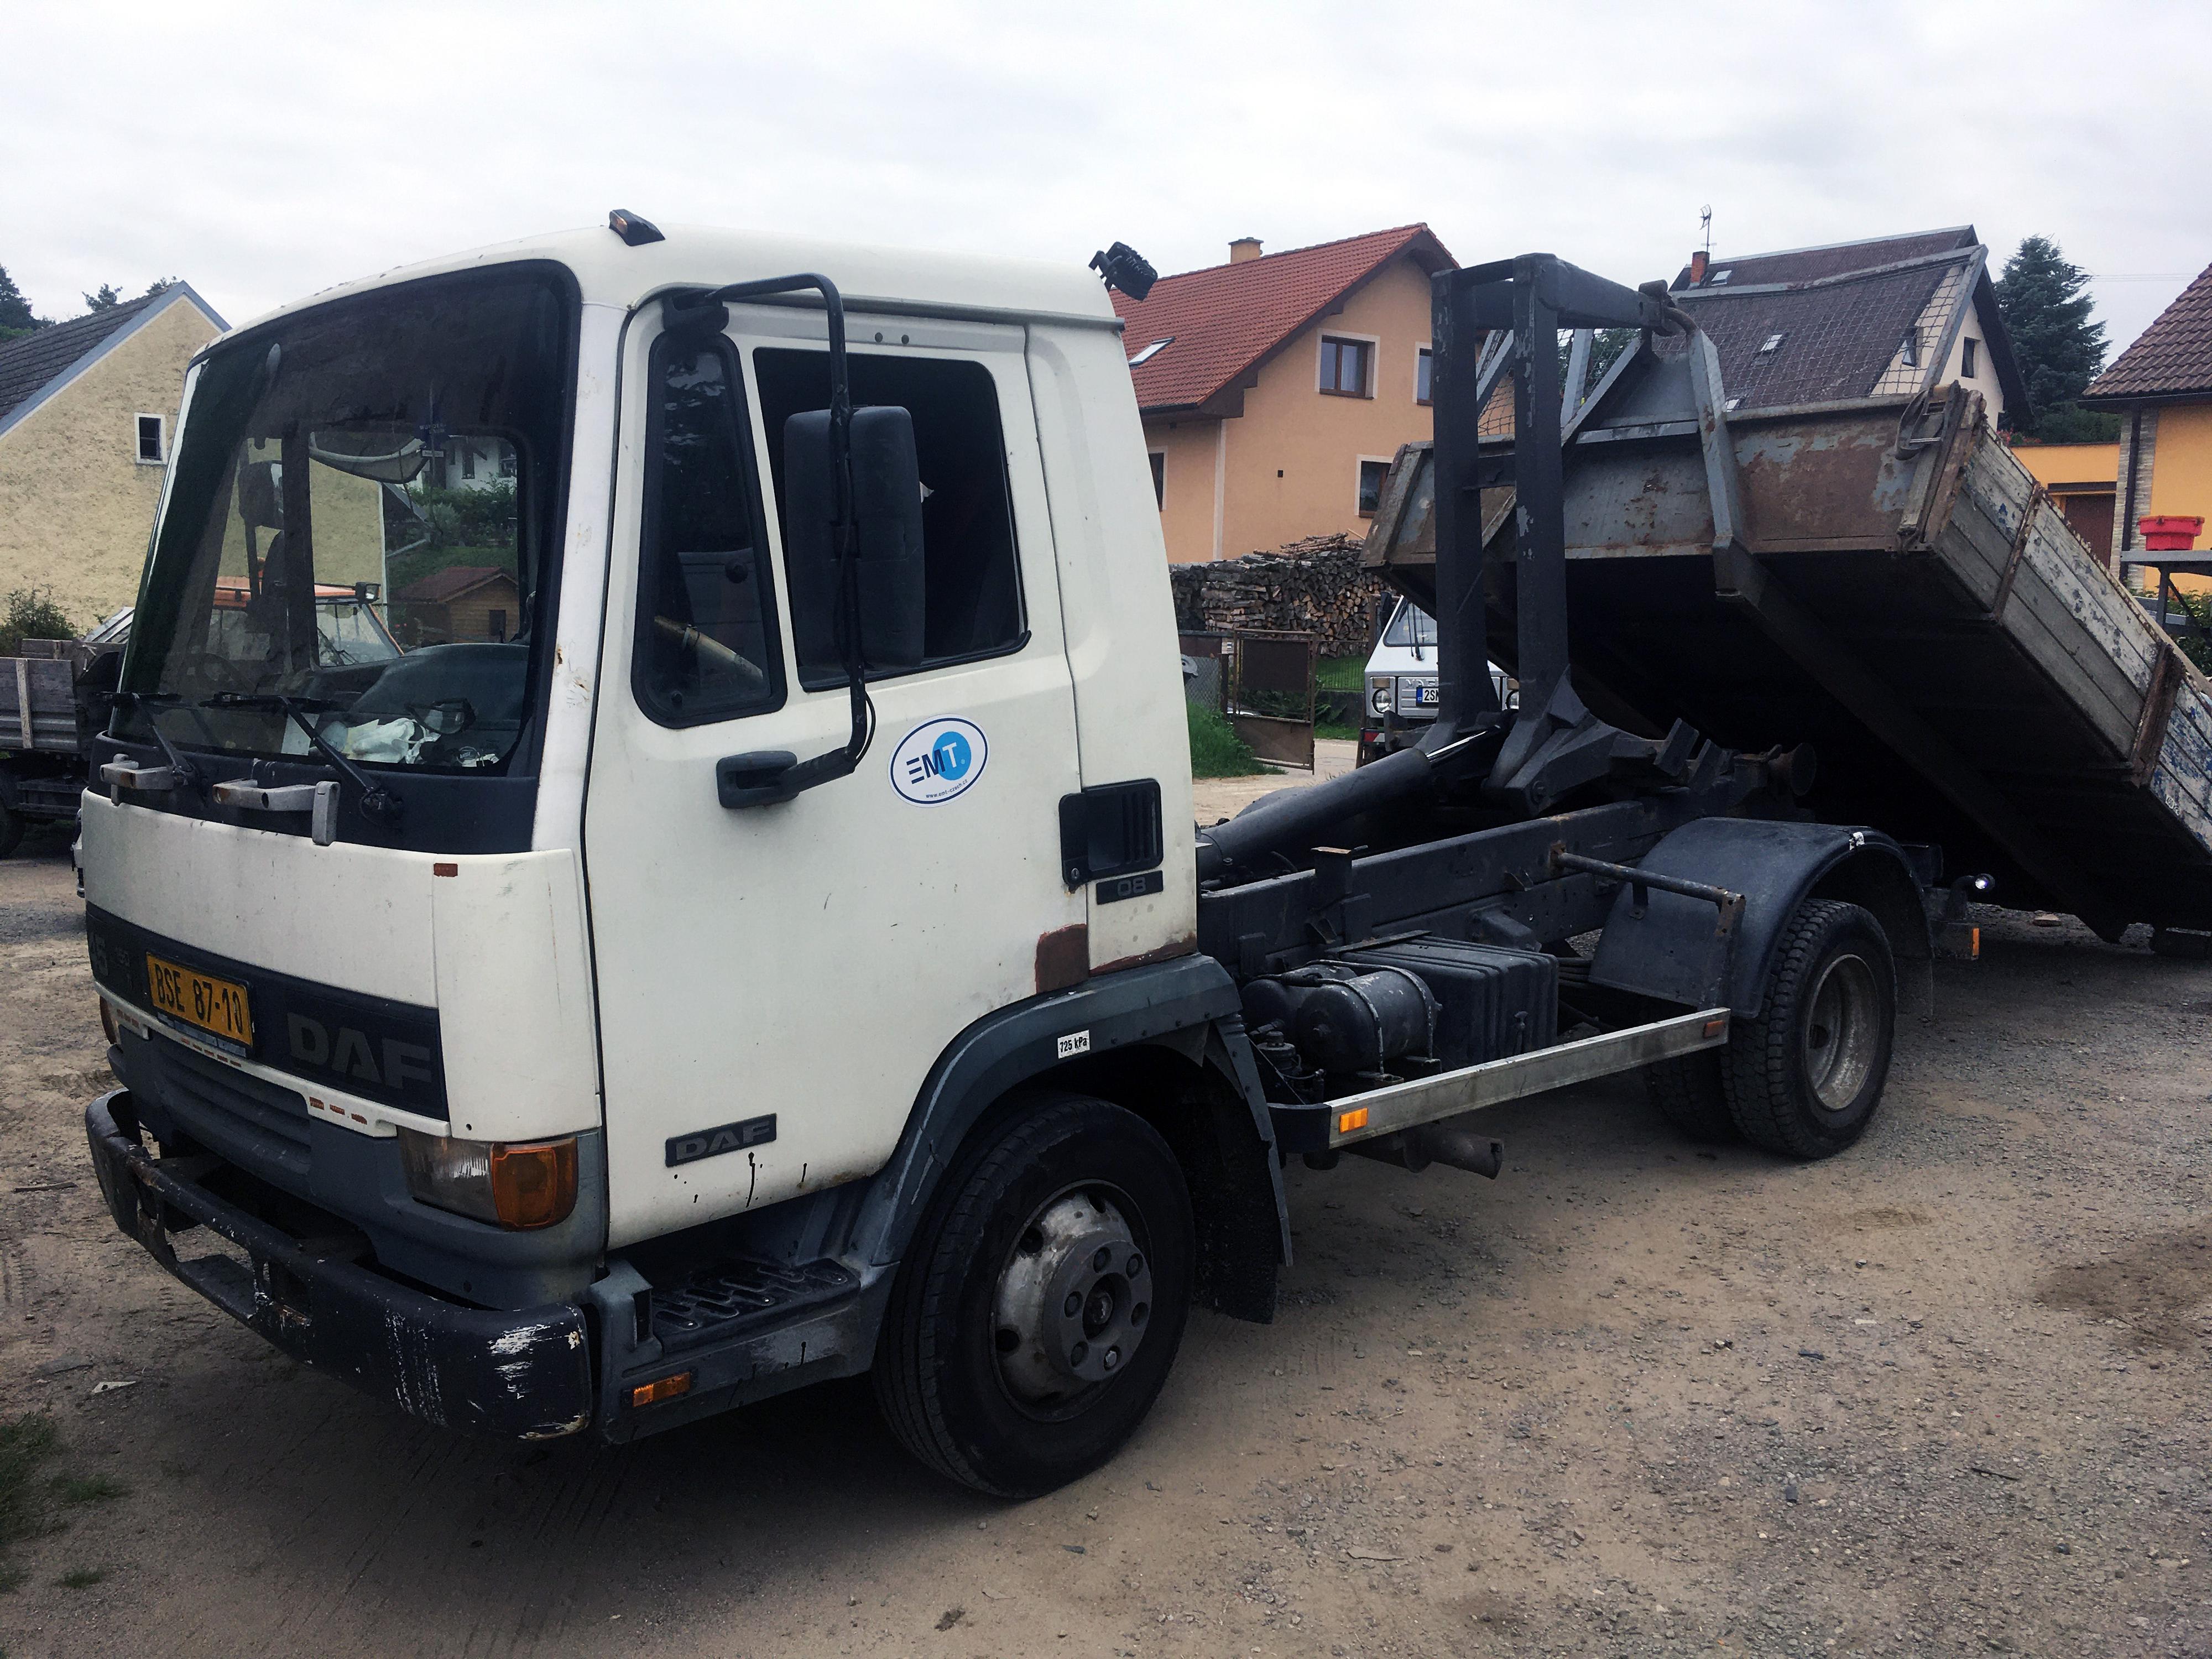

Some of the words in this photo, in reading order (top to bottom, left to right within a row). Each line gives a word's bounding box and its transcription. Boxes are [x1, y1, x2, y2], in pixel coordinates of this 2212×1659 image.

[926, 779, 968, 798] www.emt-czech.cz
[1118, 877, 1146, 896] 08
[155, 963, 185, 1012] BSE
[194, 978, 243, 1035] 87-10
[286, 1012, 432, 1089] DAF
[1060, 1040, 1073, 1053] 725
[1074, 1037, 1087, 1049] kPa
[676, 1120, 770, 1160] DAF
